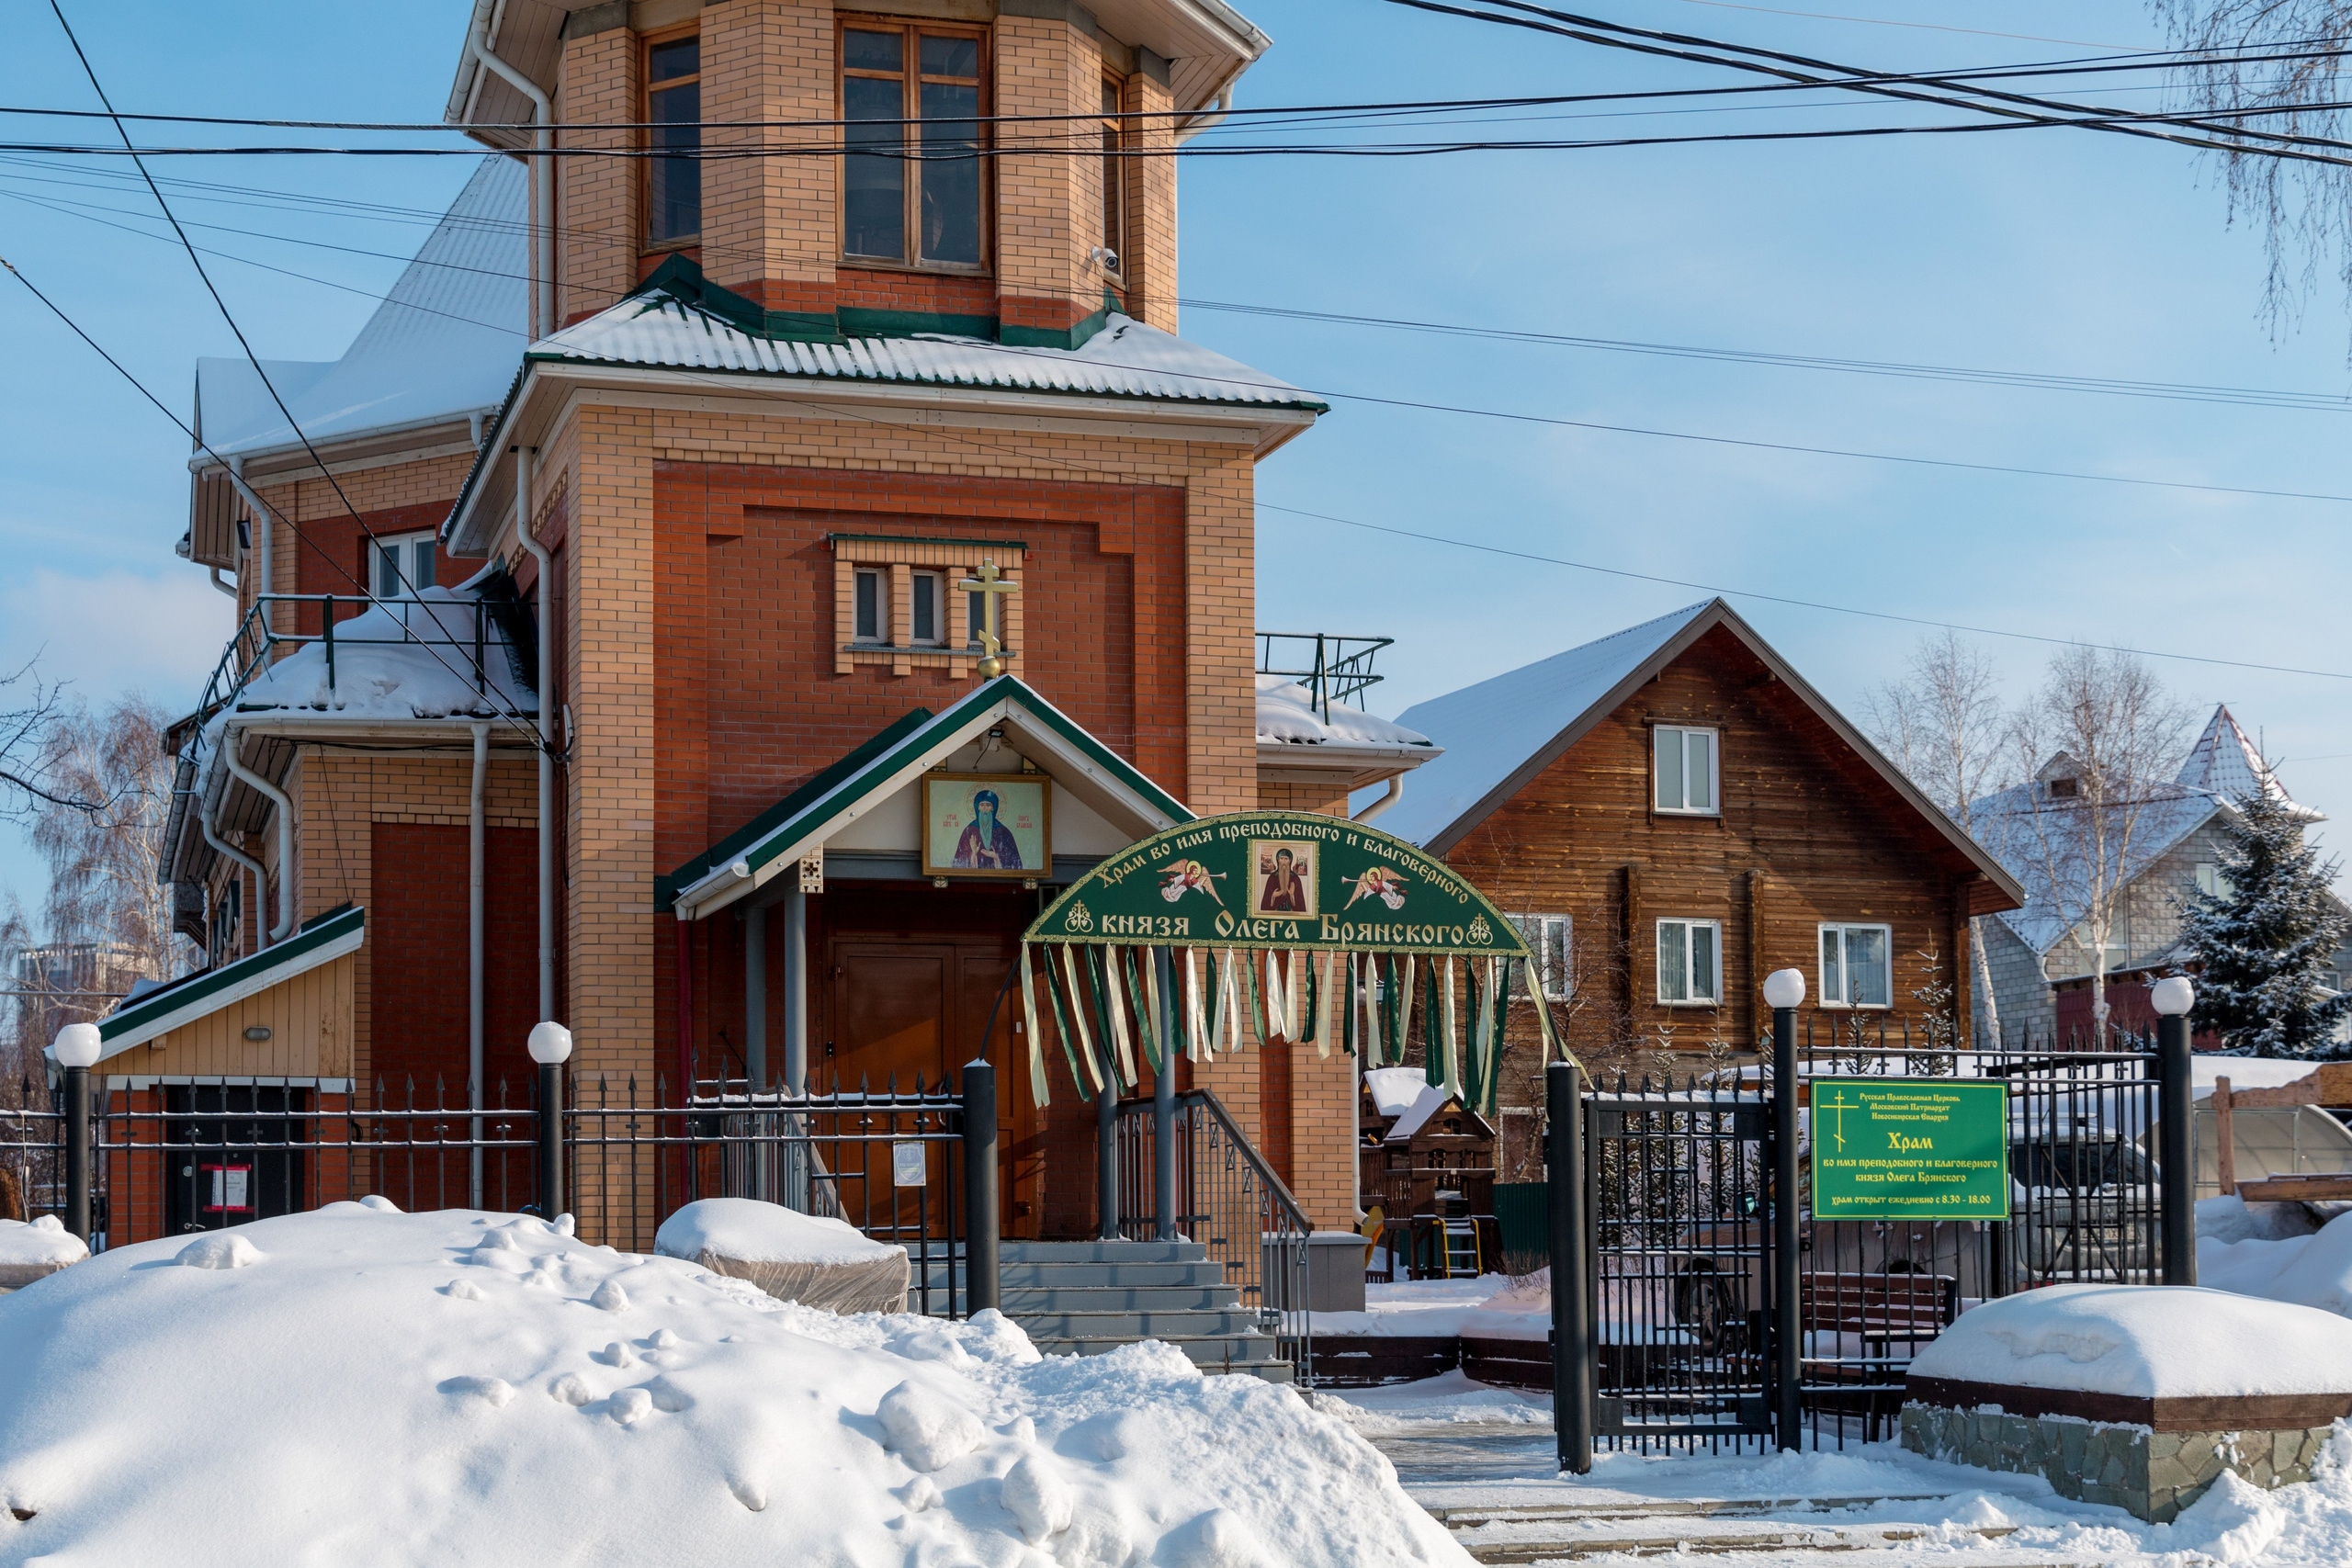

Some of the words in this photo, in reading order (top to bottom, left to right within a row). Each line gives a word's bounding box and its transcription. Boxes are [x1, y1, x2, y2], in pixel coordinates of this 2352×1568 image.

[1096, 854, 1148, 888] Храм
[1150, 842, 1170, 860] во
[1176, 829, 1213, 850] имя
[1219, 822, 1340, 843] преподобного
[1346, 833, 1358, 846] и
[1363, 838, 1468, 904] благоверного
[1102, 914, 1189, 936] князя
[1215, 909, 1300, 939] Олега
[1318, 913, 1464, 949] Брянского
[1860, 1092, 1886, 1102] Русская
[1886, 1093, 1932, 1102] Православная
[1933, 1094, 1961, 1103] Церковь
[1870, 1102, 1909, 1111] Московский
[1910, 1103, 1951, 1112] Патриархат
[1871, 1112, 1920, 1122] Новосибирская
[1920, 1113, 1949, 1122] Епархия
[1887, 1132, 1933, 1154] Храм
[1823, 1158, 1835, 1167] во
[1837, 1158, 1857, 1167] имя
[1859, 1159, 1924, 1169] преподобного
[1926, 1159, 1932, 1168] и
[1934, 1159, 1998, 1170] благоверного
[1855, 1174, 1885, 1182] князя
[1886, 1171, 1916, 1182] Олега
[1917, 1171, 1966, 1185] Брянского
[1831, 1196, 1853, 1206] храм
[1854, 1196, 1886, 1206] открыт
[1888, 1197, 1934, 1205] ежедневно
[1941, 1194, 1962, 1204] 8.30
[1968, 1194, 1991, 1204] 18.00
